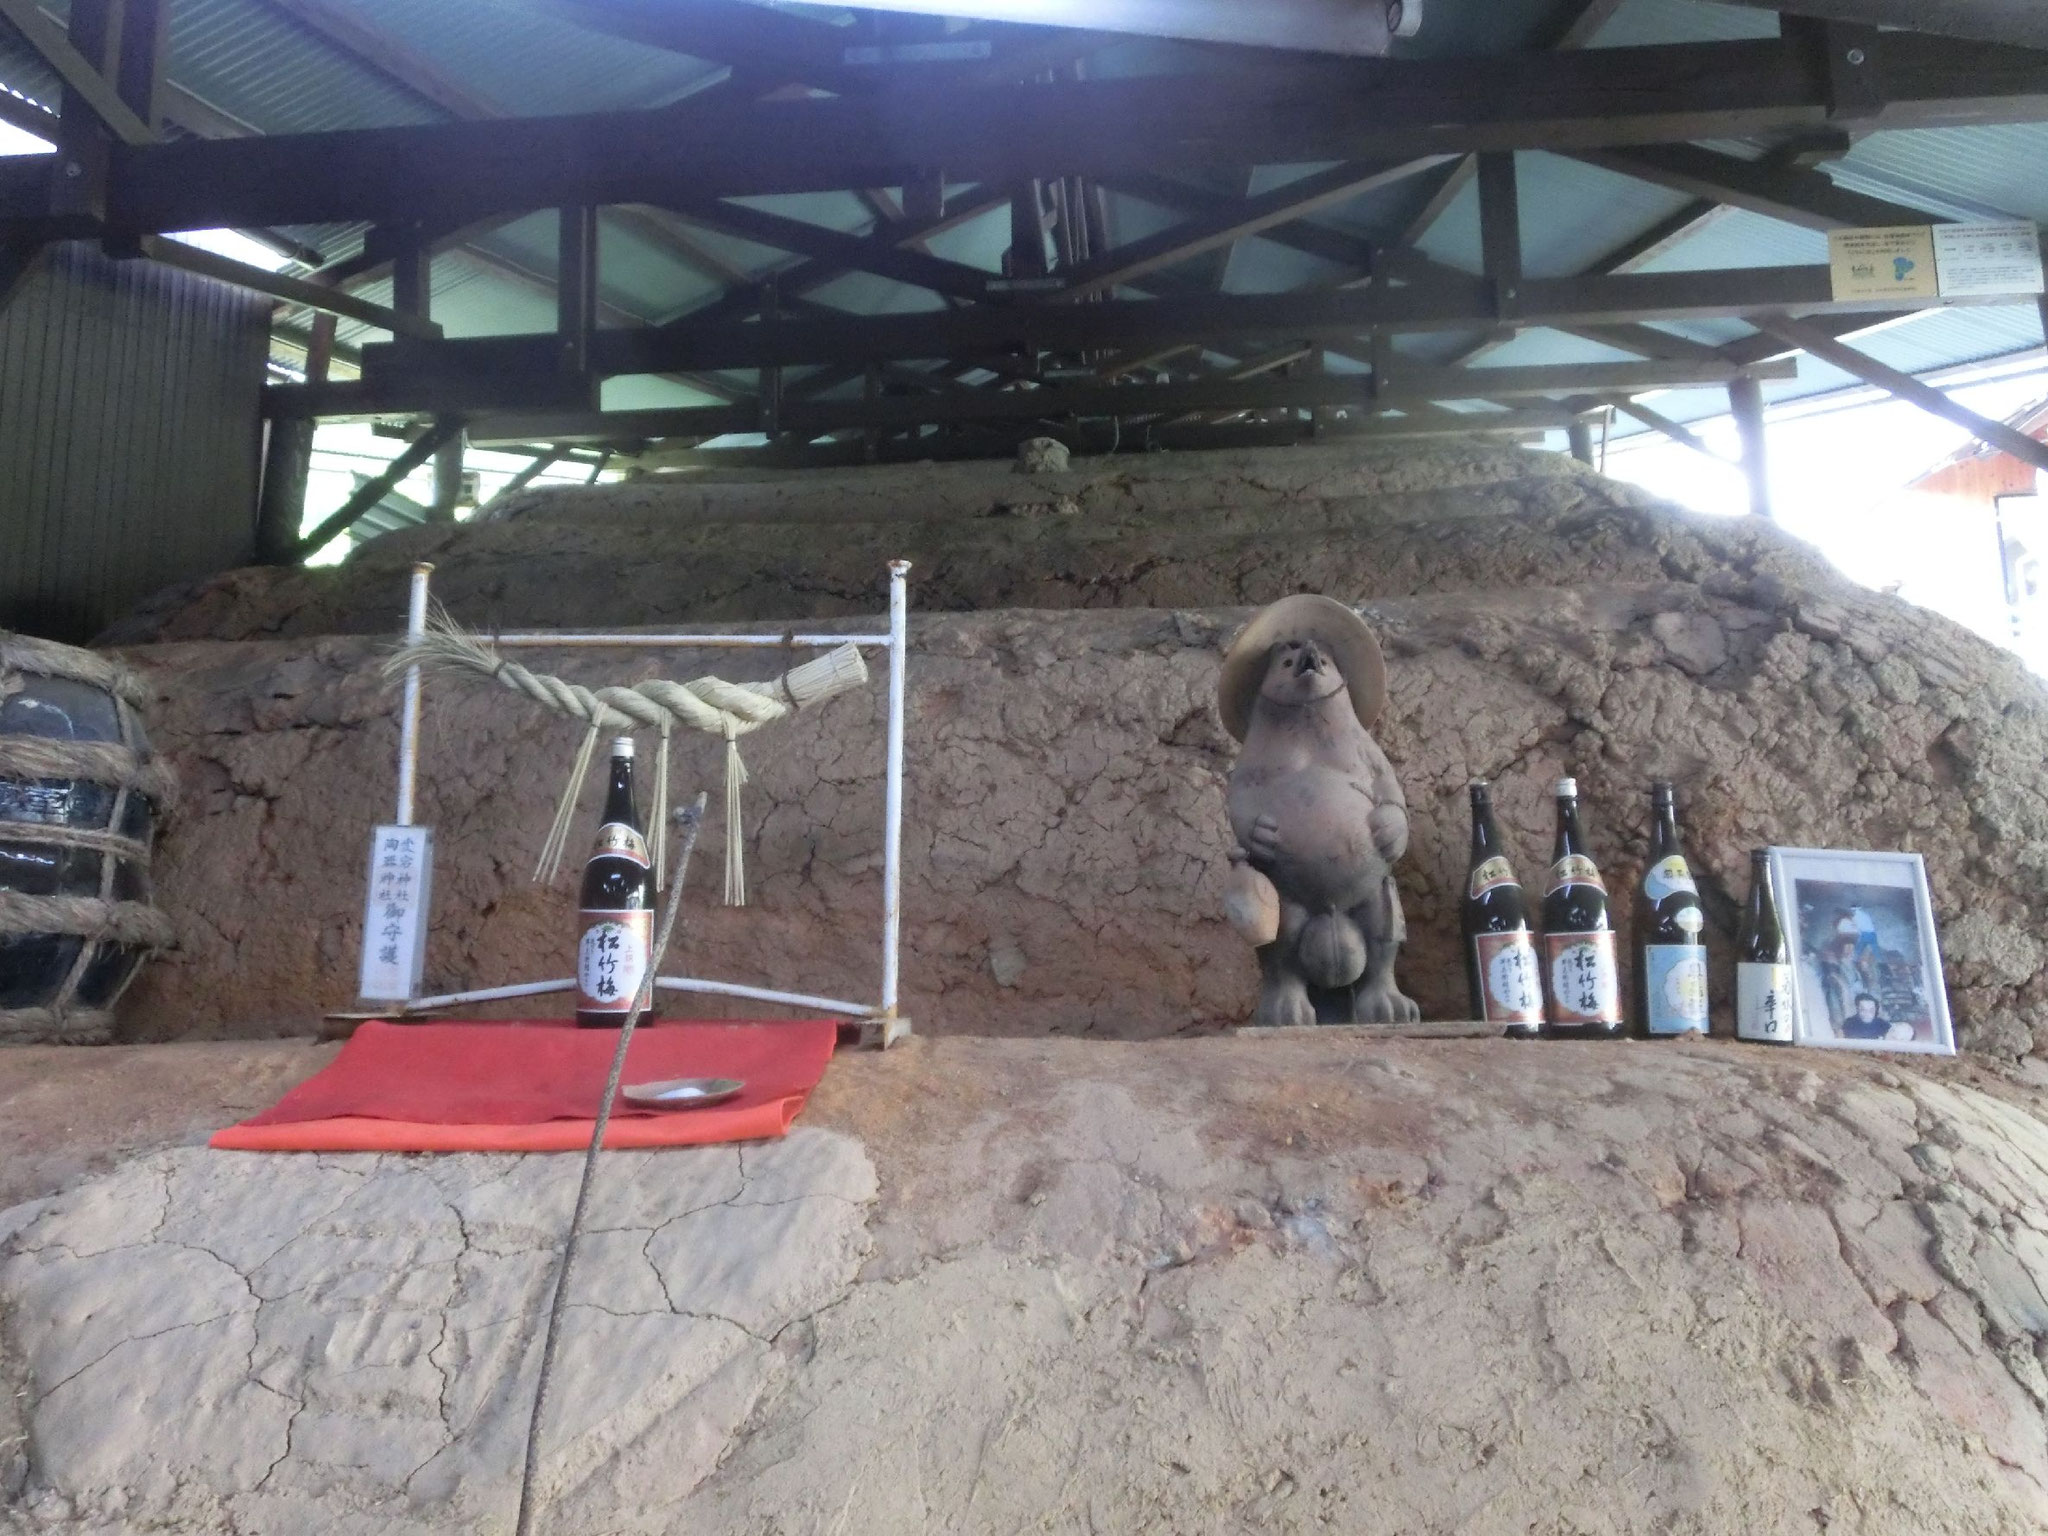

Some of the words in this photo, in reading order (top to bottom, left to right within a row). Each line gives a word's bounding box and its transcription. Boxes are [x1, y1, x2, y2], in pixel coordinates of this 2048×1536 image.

[596, 930, 620, 997] 松竹梅
[1574, 950, 1600, 1011] 松竹梅
